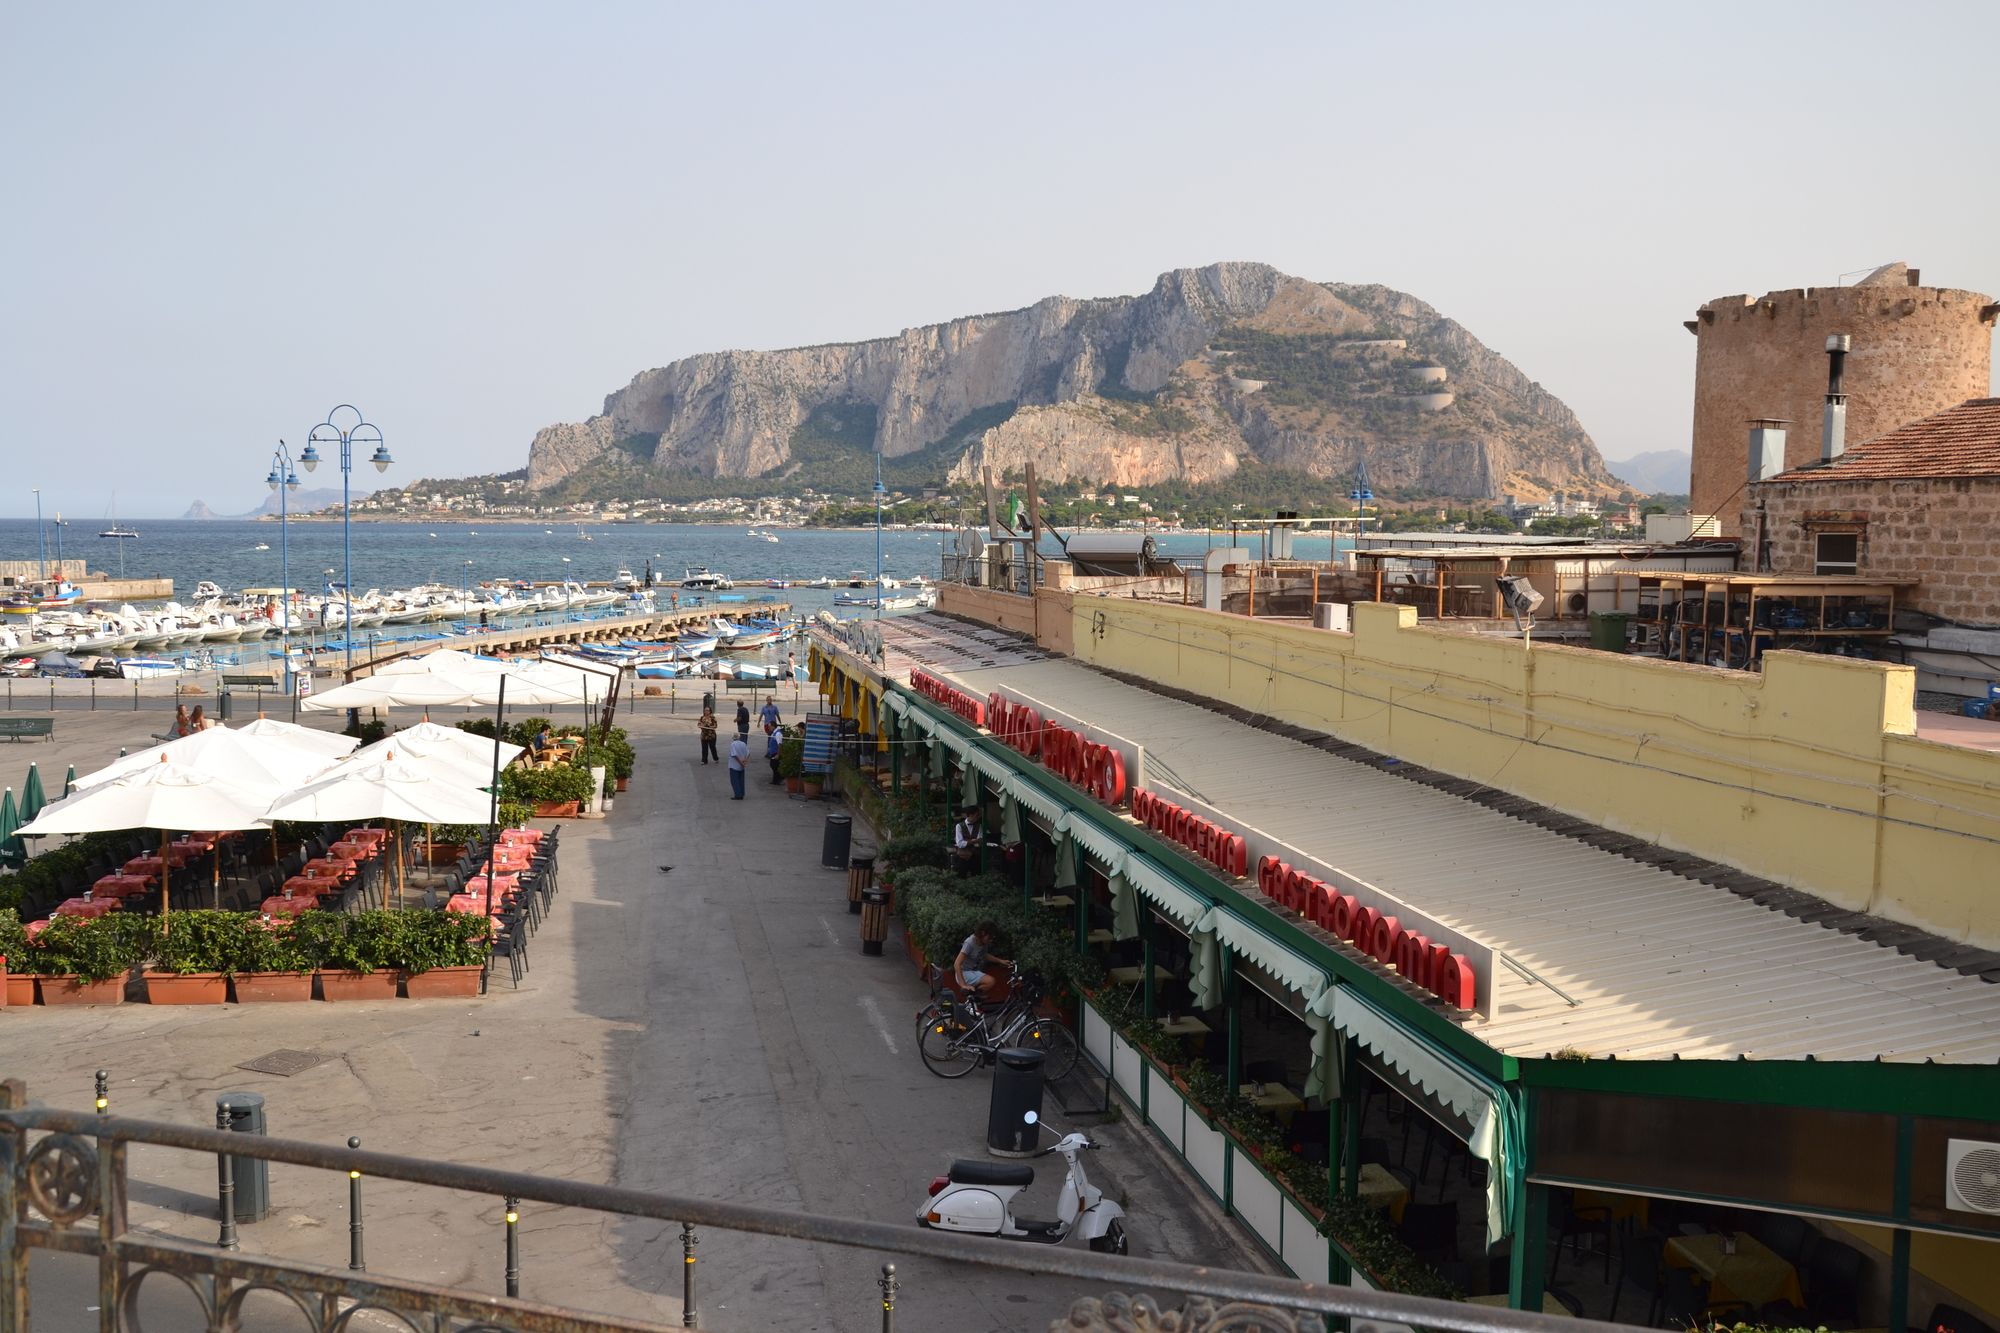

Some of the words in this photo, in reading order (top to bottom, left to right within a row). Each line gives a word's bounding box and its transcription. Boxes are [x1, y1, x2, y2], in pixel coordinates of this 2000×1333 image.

[1041, 719, 1126, 805] CHIOSCO
[1131, 786, 1248, 876] ROSTICCERIA
[1257, 855, 1476, 1010] GASTRONOMIA
